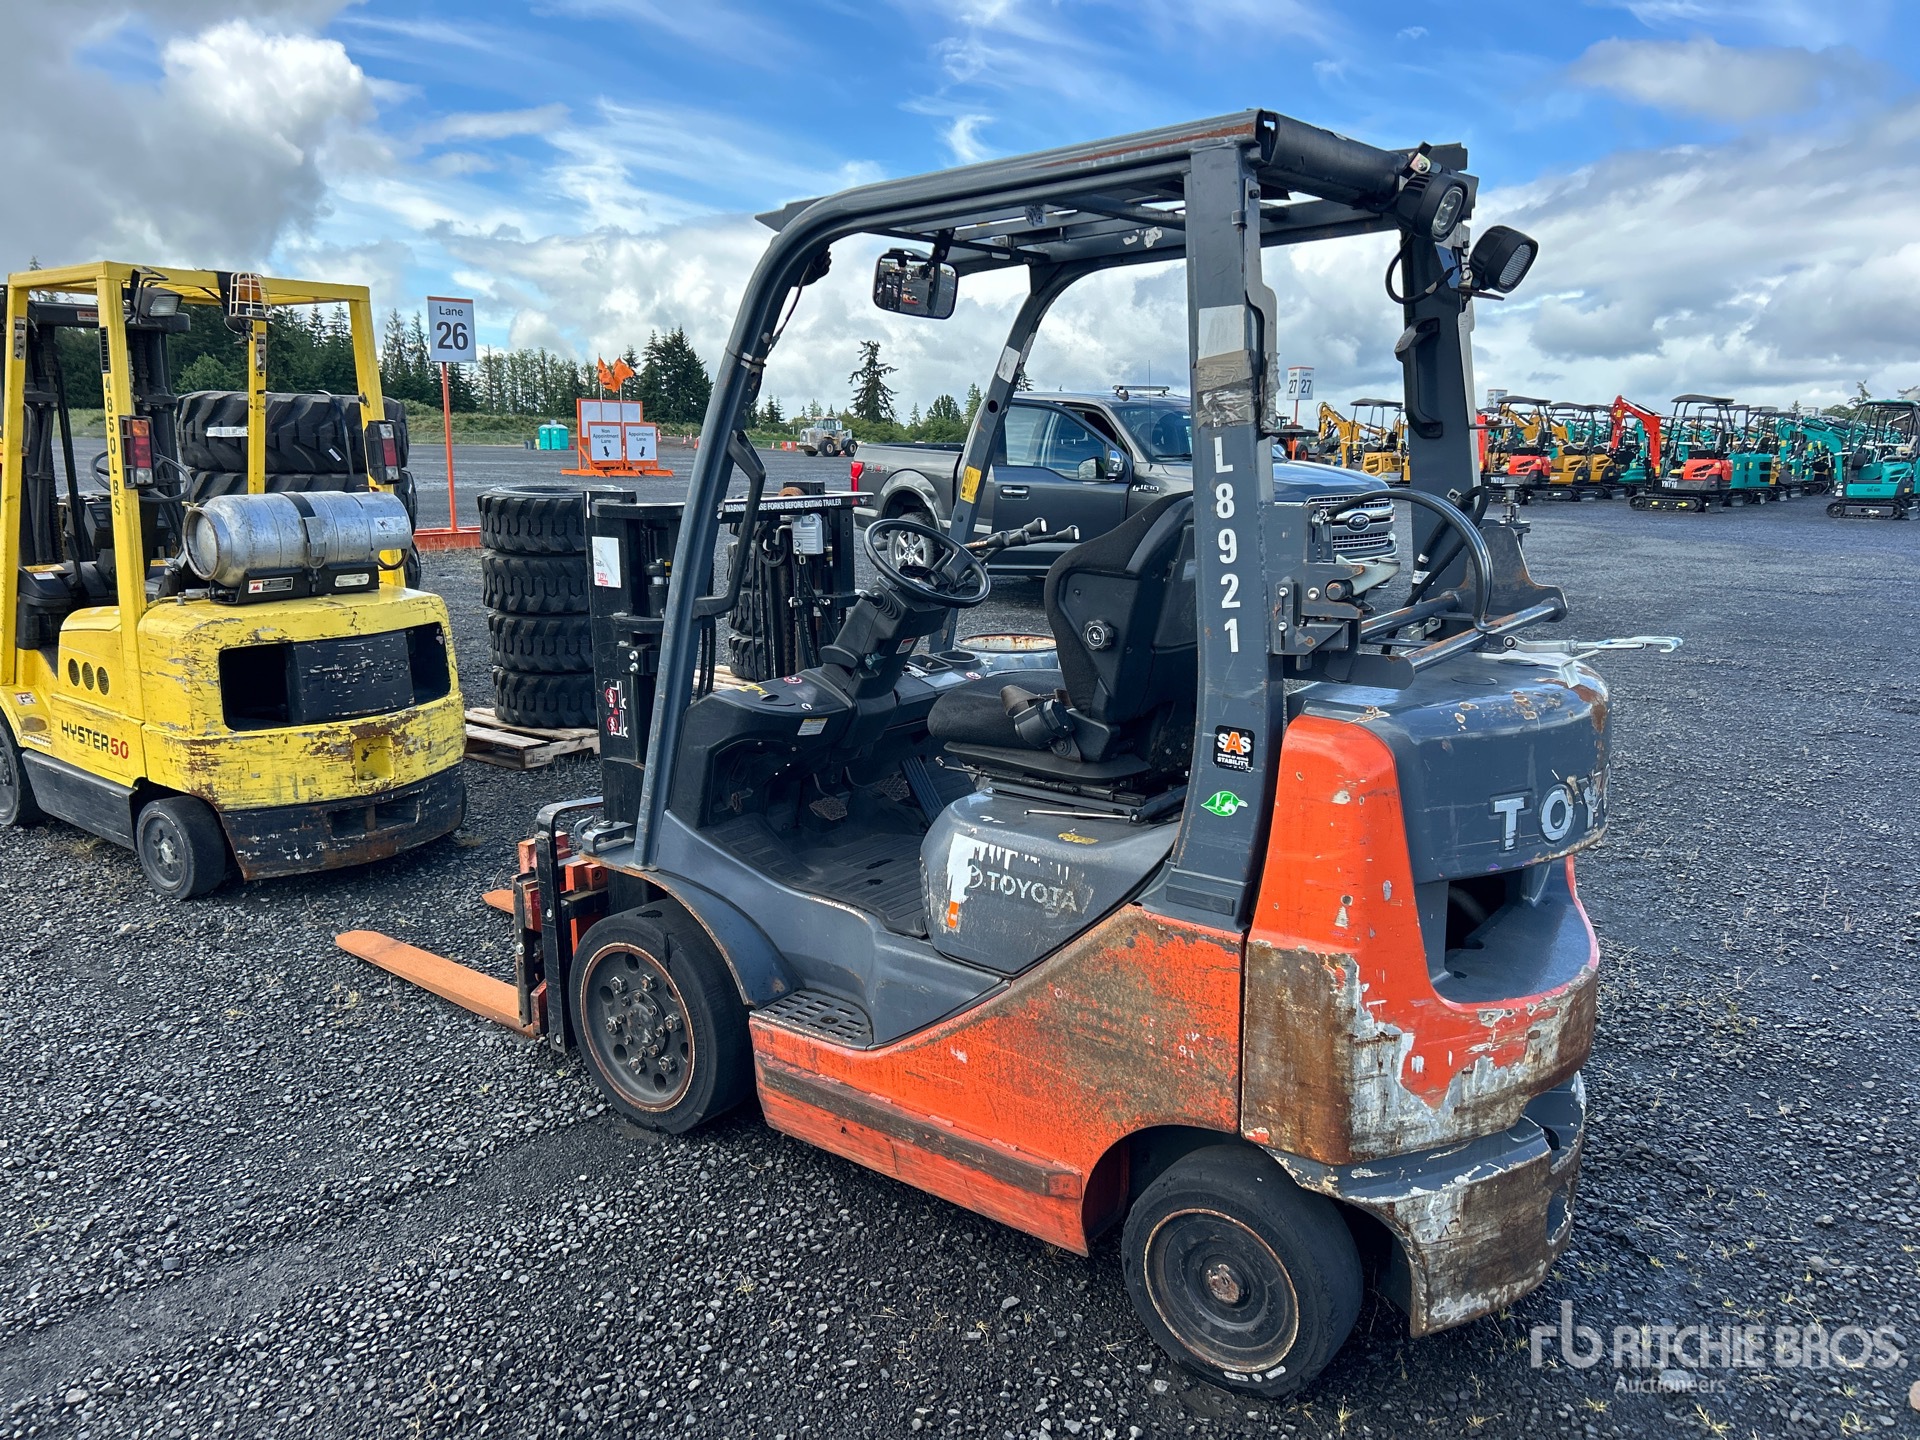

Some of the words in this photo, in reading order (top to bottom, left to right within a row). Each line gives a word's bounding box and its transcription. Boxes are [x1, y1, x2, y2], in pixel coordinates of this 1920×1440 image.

[438, 305, 464, 317] Lane
[436, 321, 469, 351] 26
[1288, 379, 1298, 394] 27
[1300, 379, 1312, 394] 27
[725, 503, 747, 513] WARNIN
[767, 501, 785, 511] FORKS
[785, 500, 804, 510] BEFORE
[804, 499, 823, 509] EXITING
[822, 498, 842, 507] TRAILER
[1213, 436, 1241, 653] L8921
[1217, 731, 1252, 755] SAS
[1216, 756, 1249, 768] STABILITY
[986, 870, 1078, 913] TOYOTA
